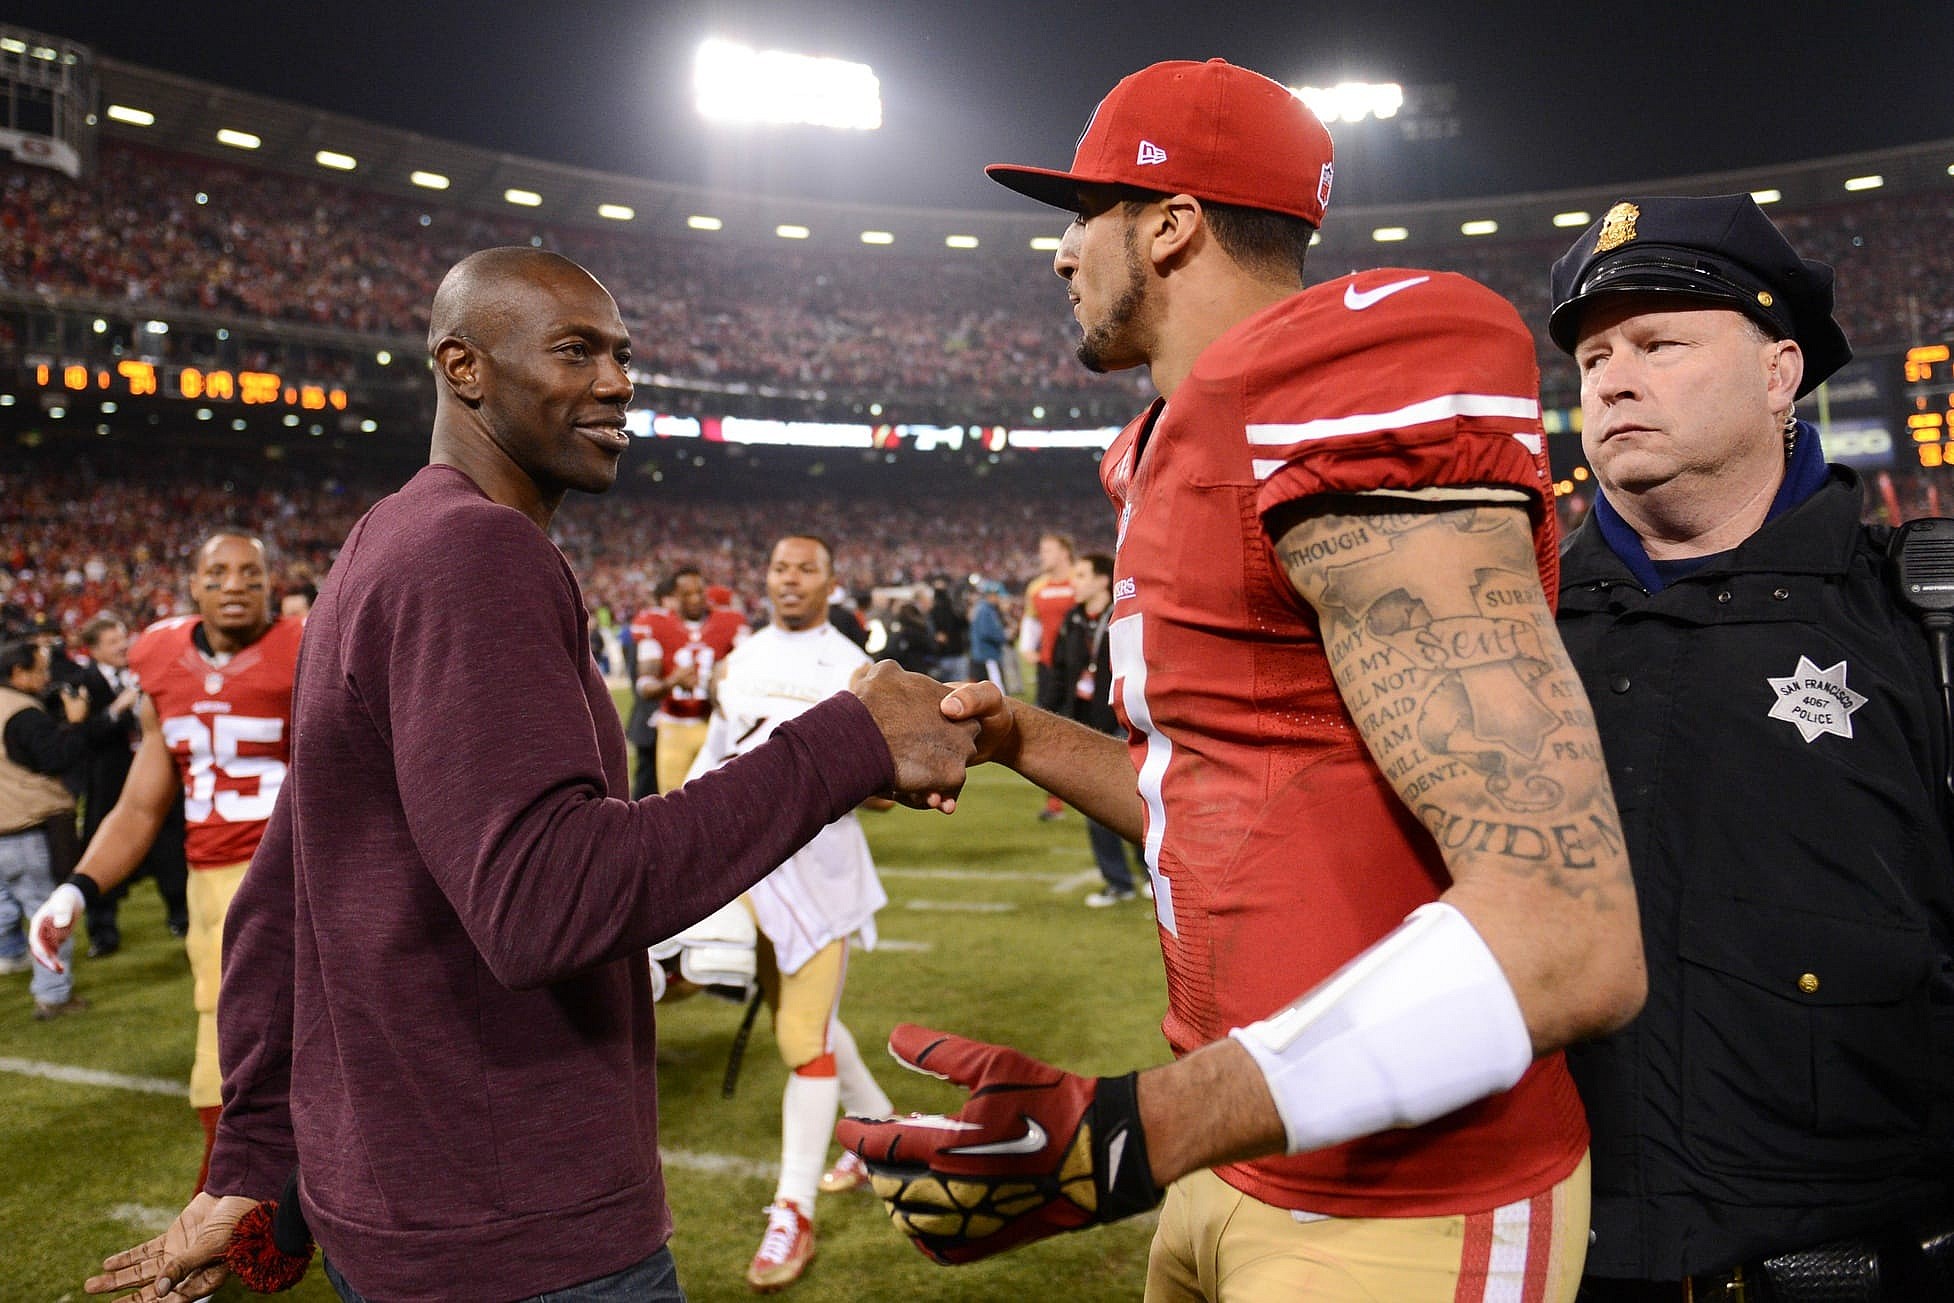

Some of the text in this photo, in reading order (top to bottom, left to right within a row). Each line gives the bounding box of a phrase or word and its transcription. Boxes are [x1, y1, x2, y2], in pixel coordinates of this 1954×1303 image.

[1291, 527, 1369, 568] THOUGH
[1359, 646, 1393, 676] MY
[1372, 665, 1418, 700] NOT
[1780, 679, 1853, 709] SAN FRANCISCO
[1791, 706, 1833, 725] POLICE
[1802, 696, 1830, 709] 4067
[1382, 723, 1412, 755] AM
[162, 714, 288, 823] 35
